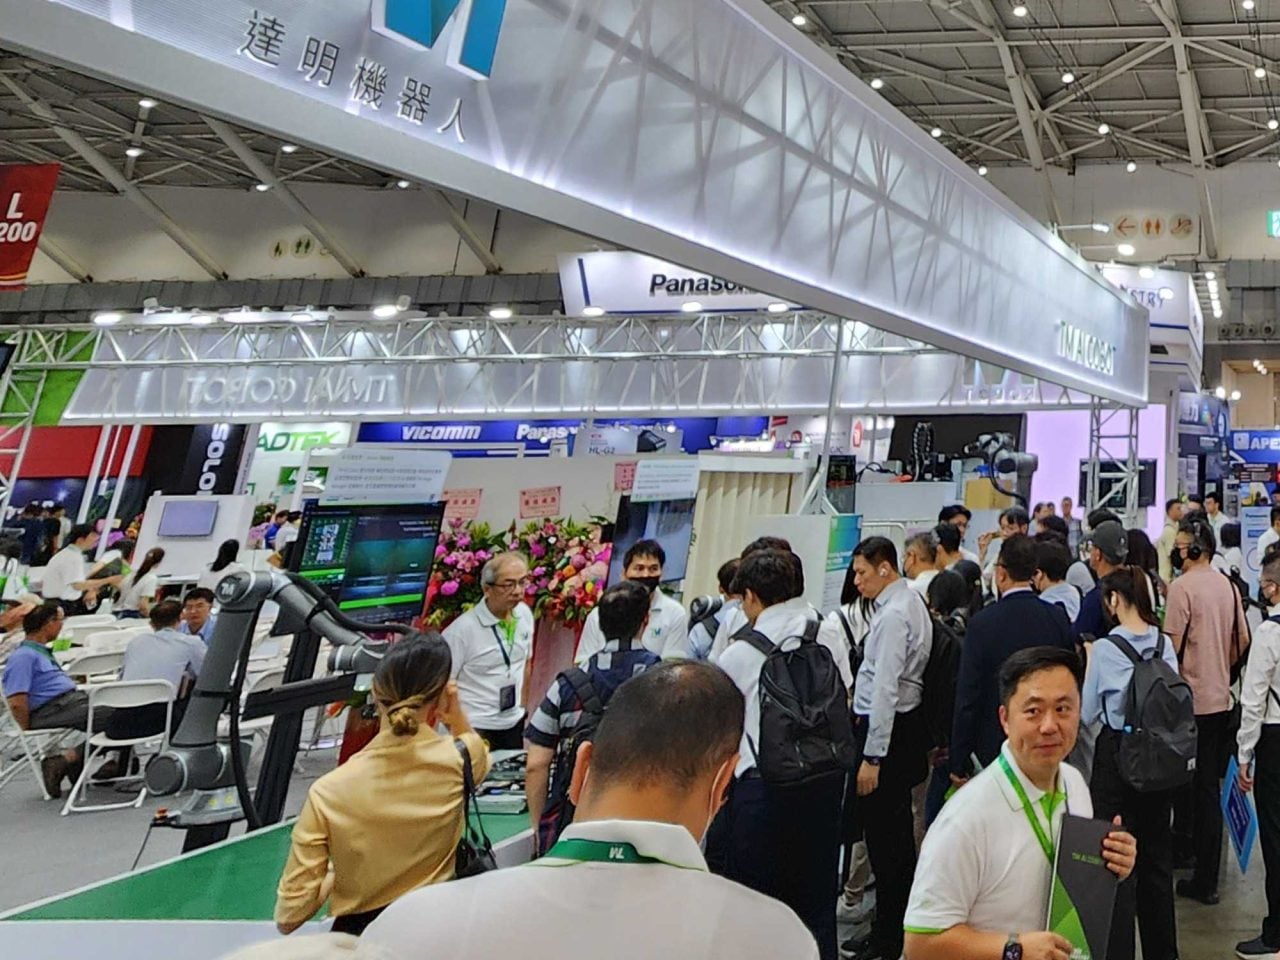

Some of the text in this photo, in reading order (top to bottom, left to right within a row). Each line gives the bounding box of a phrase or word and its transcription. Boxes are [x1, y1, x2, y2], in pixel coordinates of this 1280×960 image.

[237, 9, 467, 143] 達明機器人
[6, 192, 24, 219] L
[649, 273, 752, 294] Panaso
[197, 423, 231, 495] SOLO
